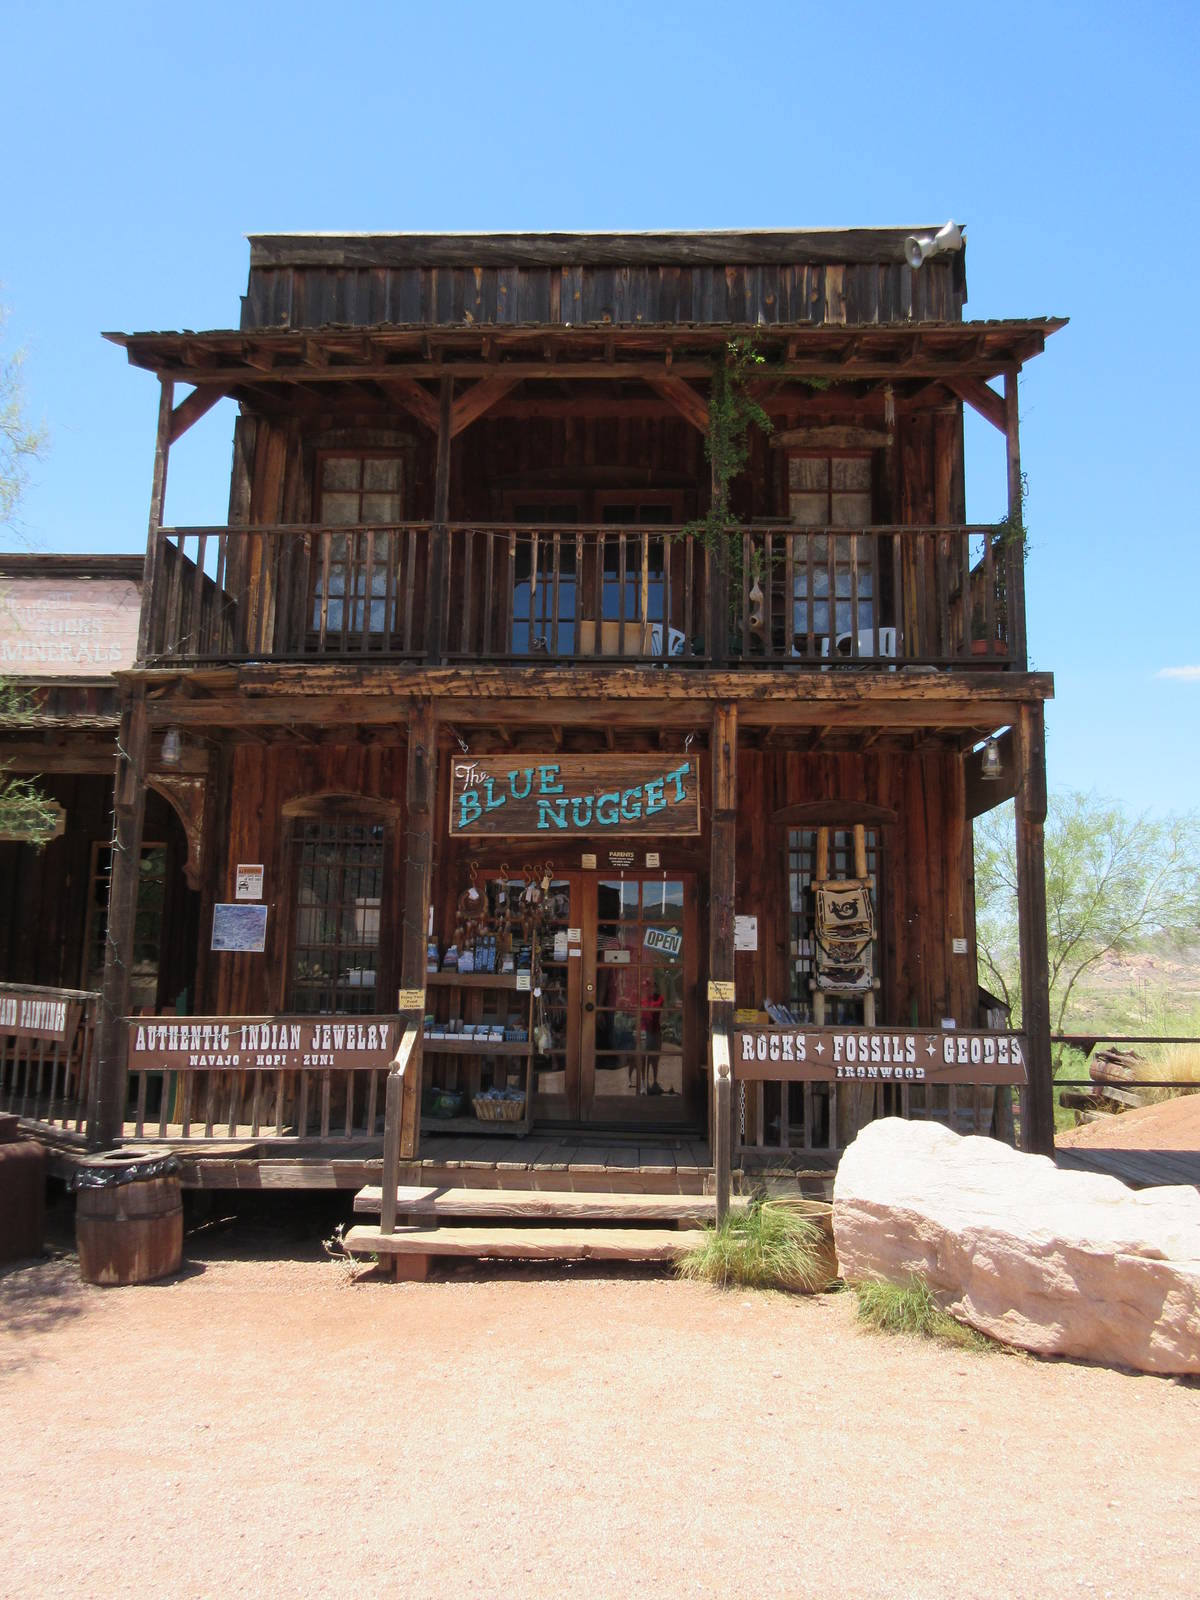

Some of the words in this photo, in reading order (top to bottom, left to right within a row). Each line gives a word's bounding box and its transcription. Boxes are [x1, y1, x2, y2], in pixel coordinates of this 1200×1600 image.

[1, 640, 123, 662] MINERALS
[455, 760, 490, 790] The
[458, 764, 564, 829] BLUE
[537, 762, 690, 829] NUGGET
[648, 930, 680, 952] OPEN
[20, 1000, 67, 1032] PAINTINGS
[135, 1024, 230, 1051] AUTHENTIC
[240, 1024, 302, 1051] INDIAN
[311, 1023, 390, 1051] JEWELRY
[741, 1034, 807, 1061] ROCKS
[832, 1035, 917, 1063] FOSSILS
[943, 1036, 1021, 1065] GEODES
[189, 1054, 241, 1067] NAVAJO
[255, 1054, 287, 1066] HOPI
[303, 1054, 335, 1066] ZUNI
[836, 1066, 925, 1079] IRONWOOD
